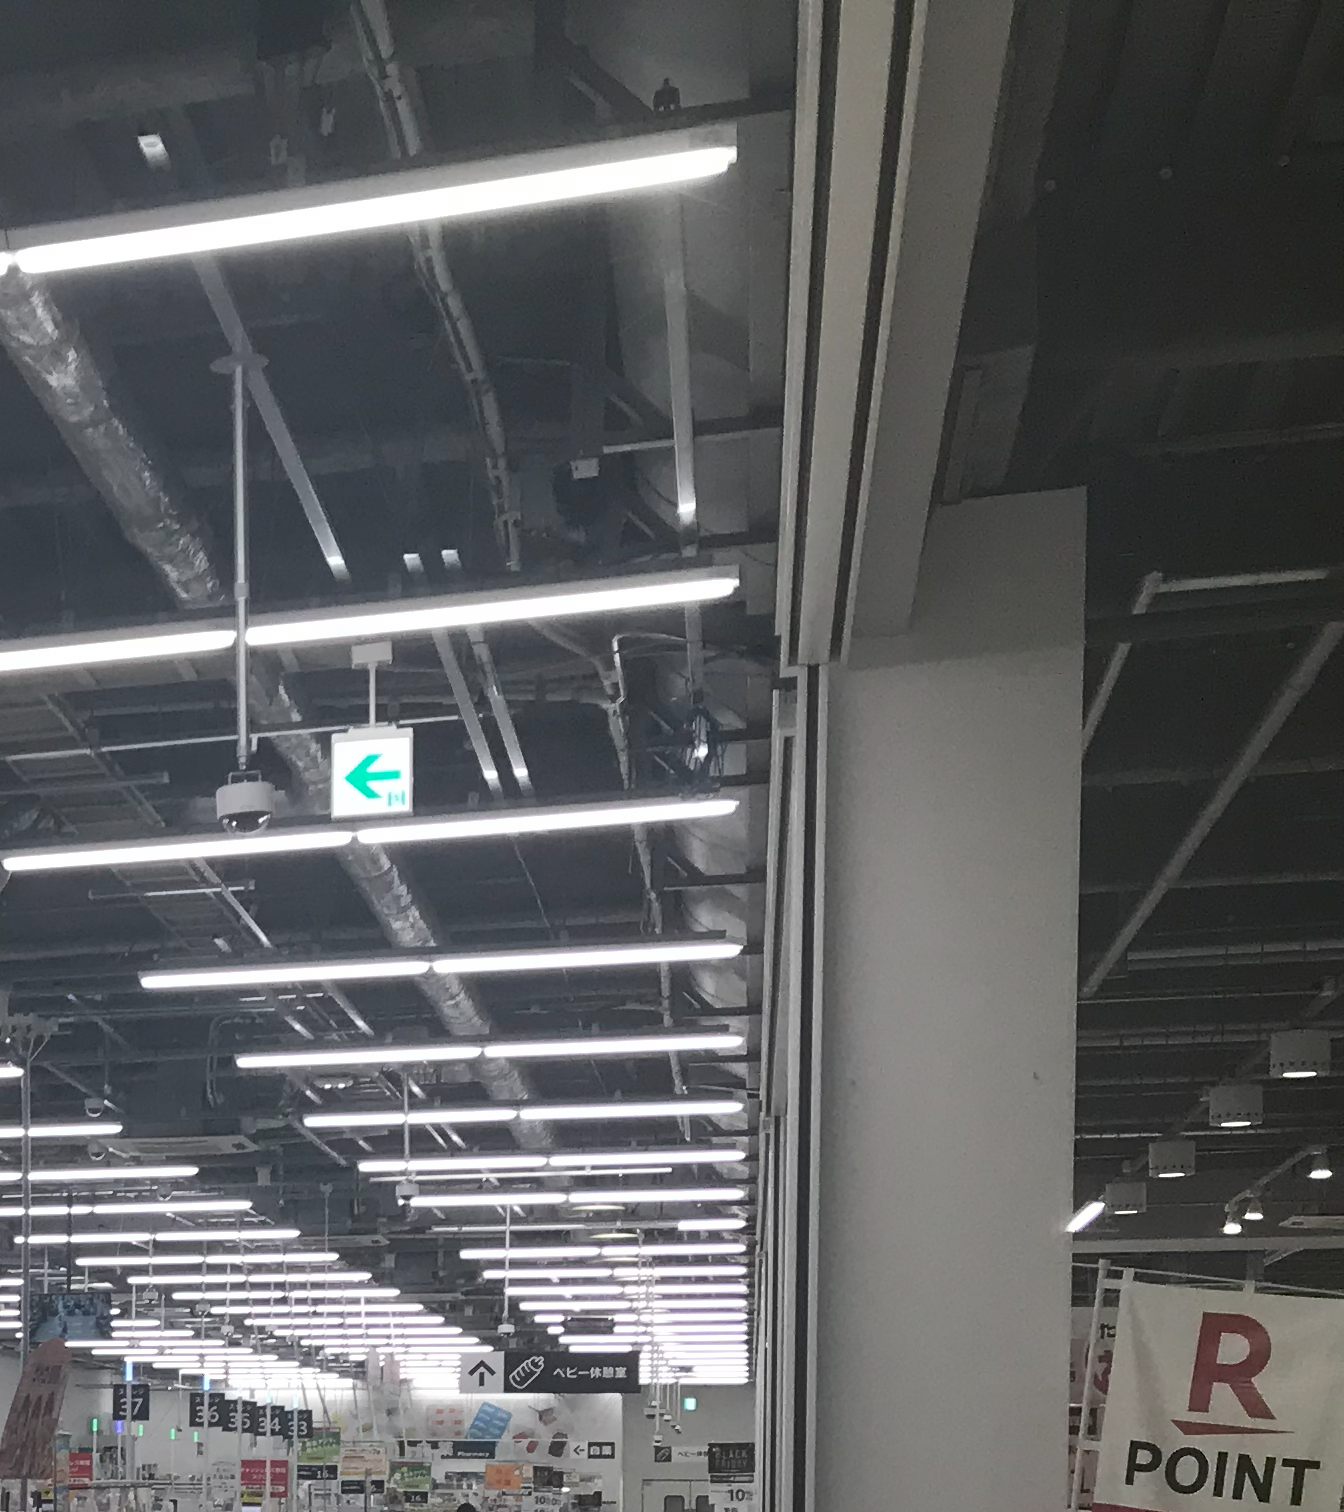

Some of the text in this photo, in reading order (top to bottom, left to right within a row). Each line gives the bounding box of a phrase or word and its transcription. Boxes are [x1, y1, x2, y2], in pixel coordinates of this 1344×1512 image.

[553, 1366, 628, 1379] ベビー休憩室
[1188, 1311, 1277, 1420] R
[119, 1397, 143, 1417] 37
[194, 1405, 220, 1423] 36
[228, 1412, 251, 1429] 35
[257, 1417, 281, 1432] 34
[287, 1420, 308, 1435] 33
[457, 1450, 490, 1458] Pharmacy
[715, 1450, 748, 1460] BLACK
[715, 1459, 748, 1468] FRIDAY
[1125, 1440, 1321, 1506] POINT
[727, 1488, 746, 1501] 10
